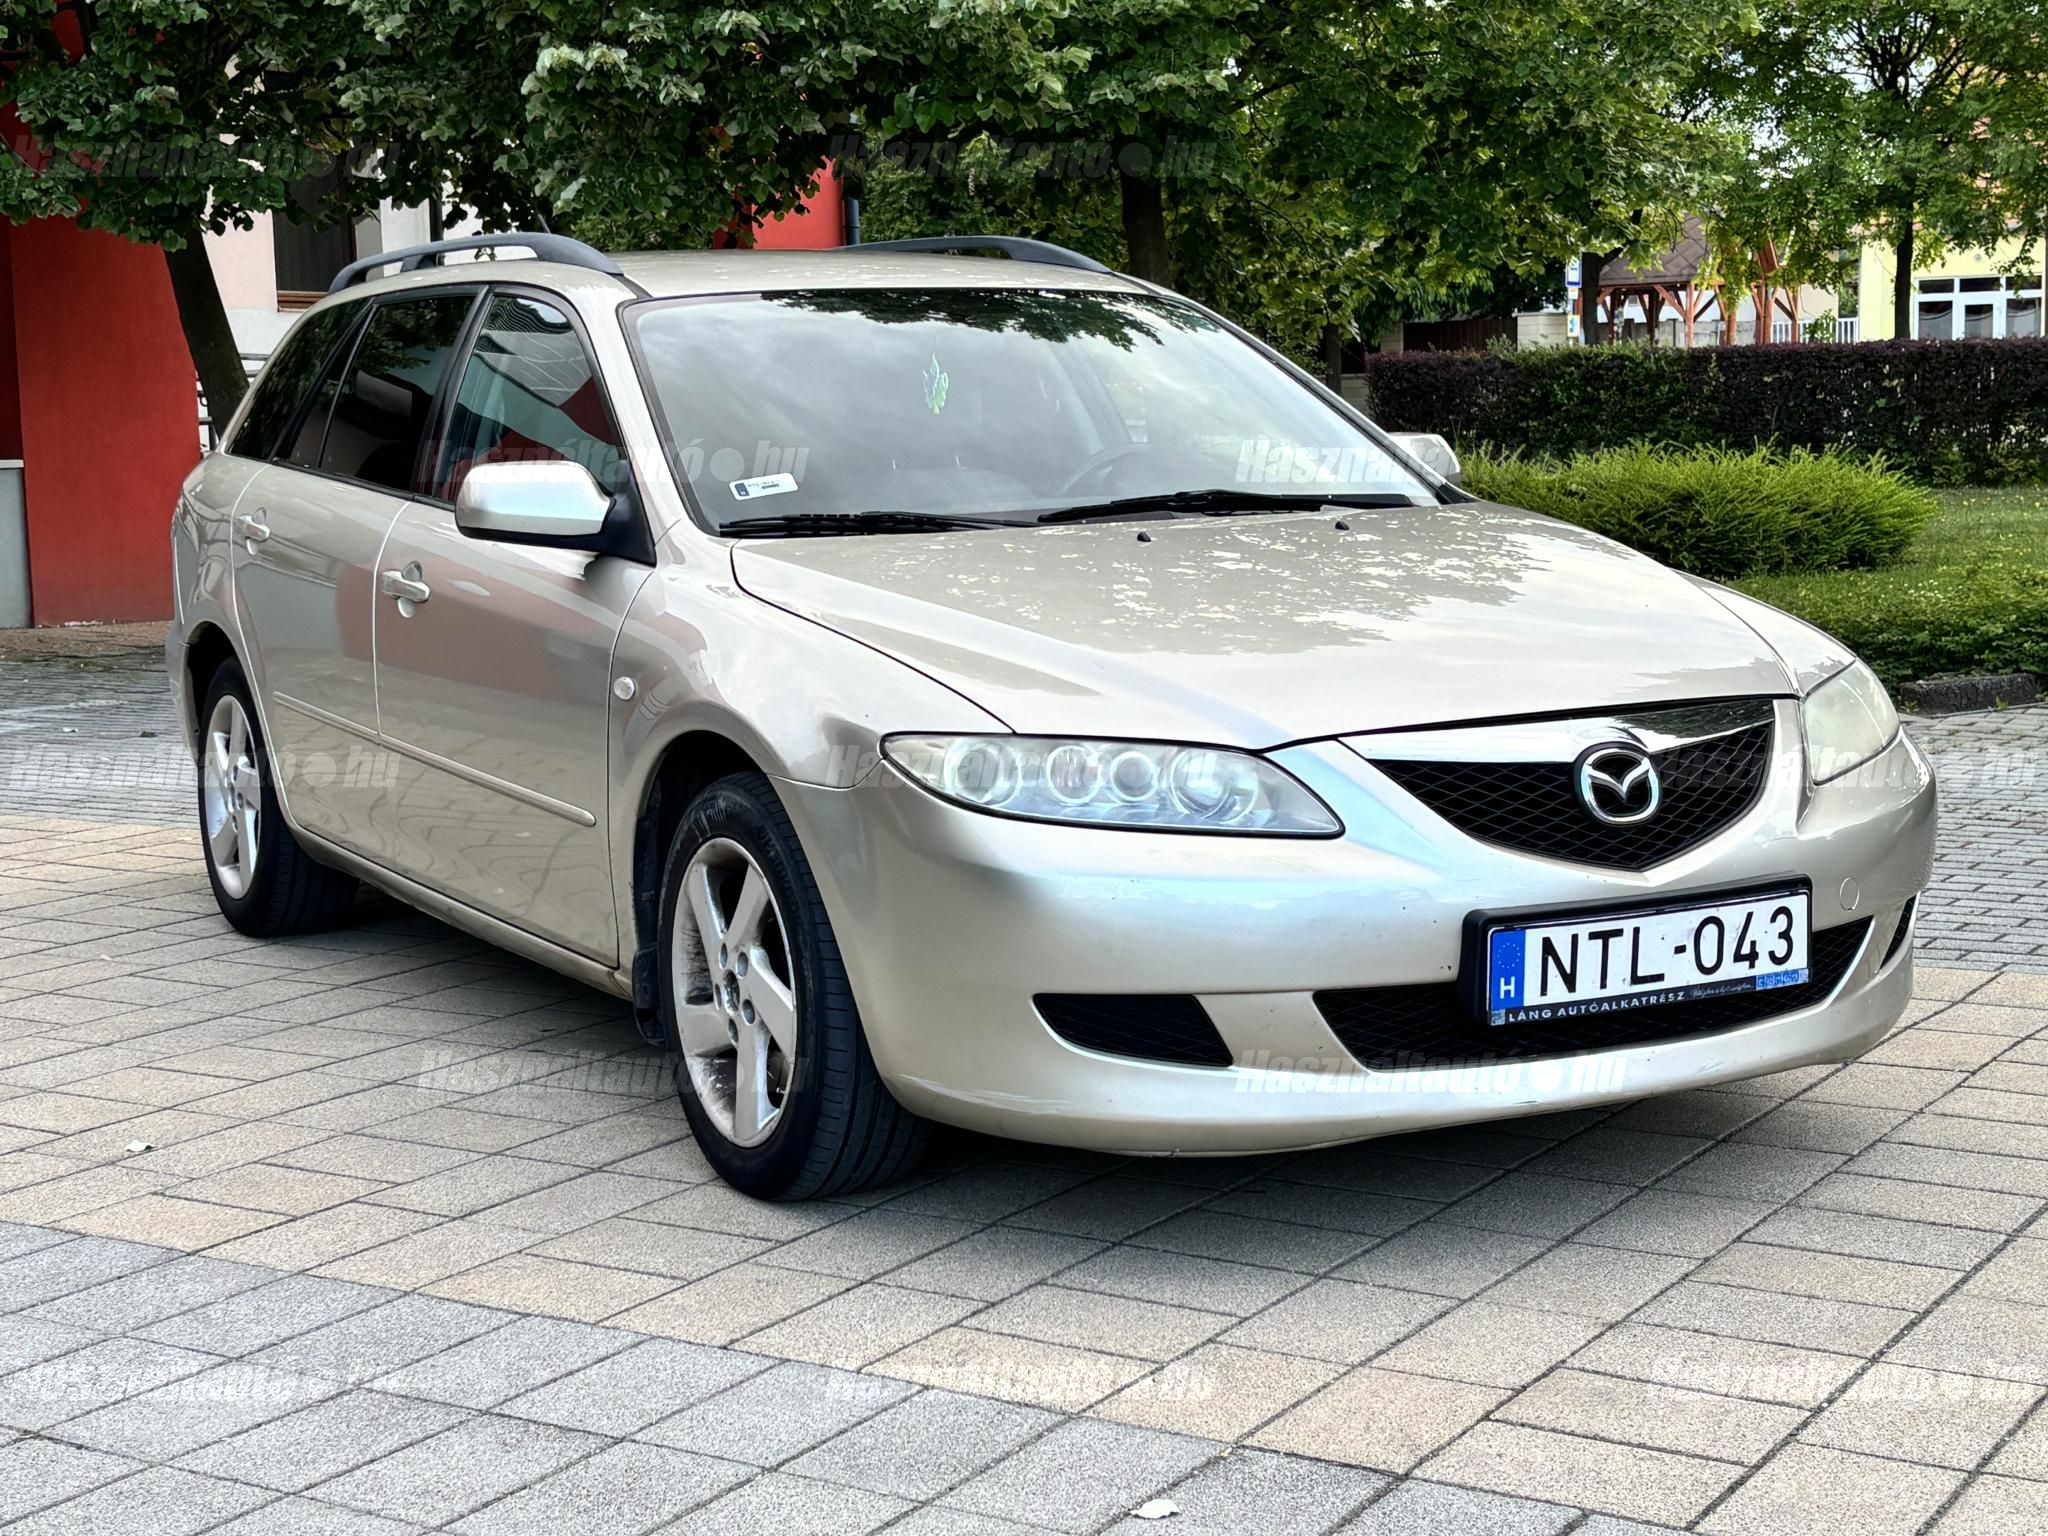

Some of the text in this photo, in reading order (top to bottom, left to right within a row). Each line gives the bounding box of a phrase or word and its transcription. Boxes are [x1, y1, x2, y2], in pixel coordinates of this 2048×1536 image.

[1539, 906, 1794, 997] NTL-043
[1500, 976, 1516, 999] H
[1508, 1009, 1552, 1023] LÁNG
[1557, 990, 1686, 1017] AUTÓALKATRÉSZ
